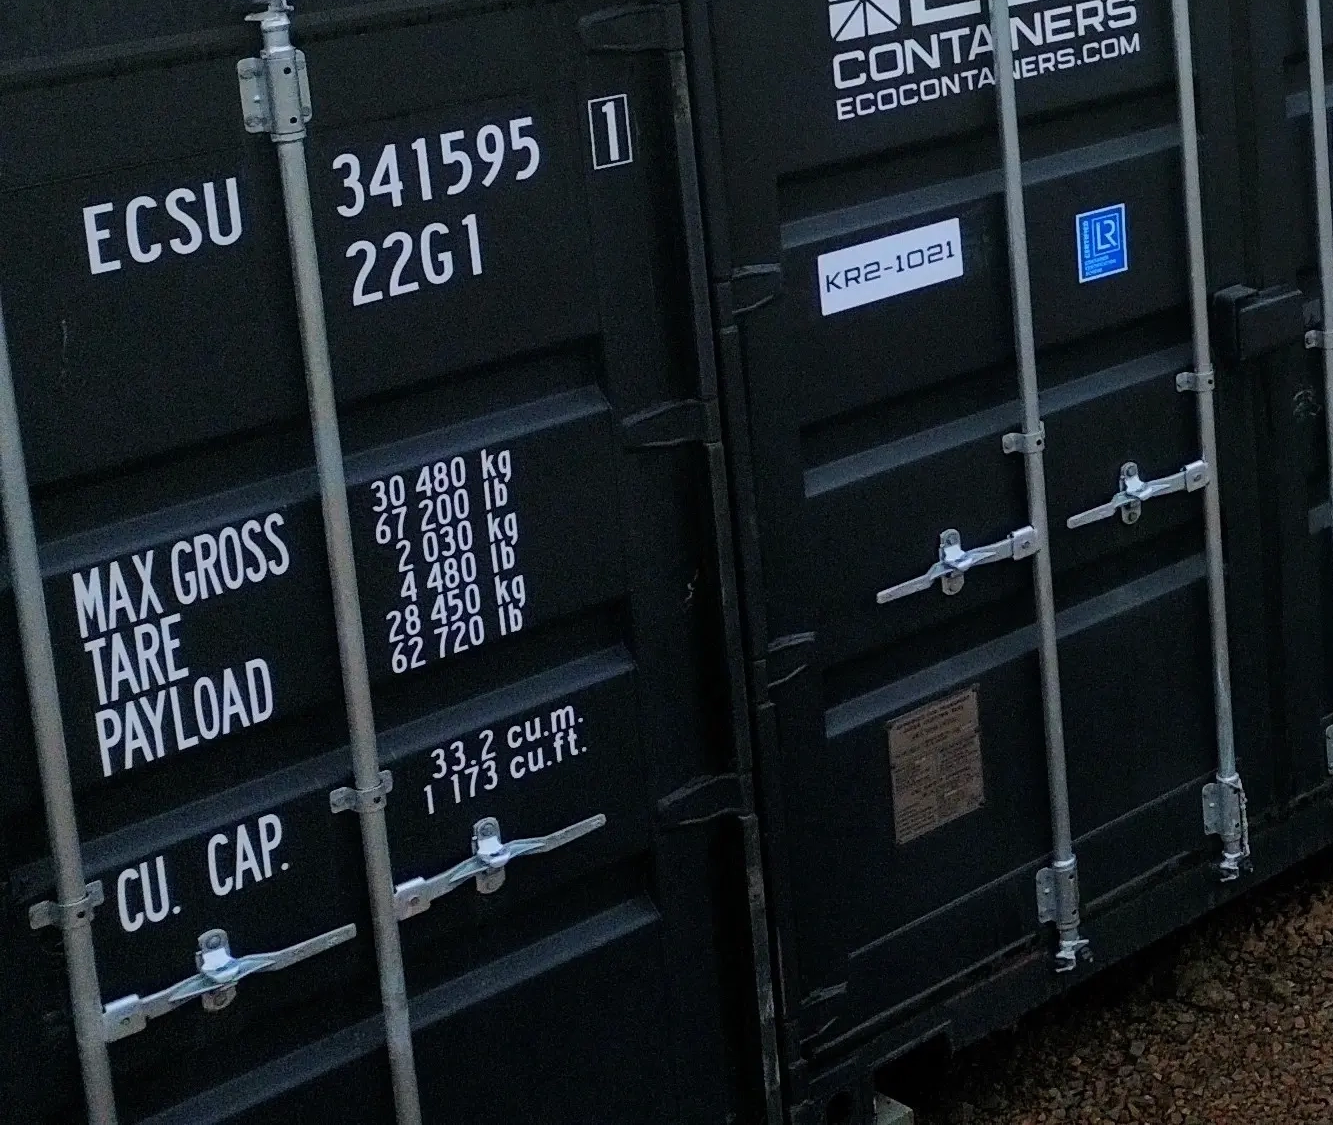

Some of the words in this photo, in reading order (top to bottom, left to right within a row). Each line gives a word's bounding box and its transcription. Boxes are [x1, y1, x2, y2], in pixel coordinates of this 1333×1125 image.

[836, 33, 1140, 120] ECOCONTAERS.COM
[83, 177, 244, 274] ECSU
[332, 116, 539, 218] 341595
[595, 97, 627, 165] 1
[346, 213, 485, 307] 22G1
[825, 241, 954, 292] KR2-1021
[371, 475, 405, 512] 30
[416, 457, 466, 496] 480
[481, 449, 512, 483] kg
[376, 506, 408, 544] 67
[418, 489, 469, 531] 200
[484, 478, 508, 510] lb
[72, 550, 163, 638] MAX
[171, 513, 289, 604] GROSS
[396, 540, 414, 572] 2
[422, 521, 473, 563] 030
[487, 512, 518, 545] kg
[400, 571, 417, 602] 4
[427, 552, 477, 593] 480
[491, 541, 515, 573] lb
[386, 604, 421, 643] 28
[431, 584, 481, 624] 450
[494, 575, 526, 608] kg
[391, 637, 426, 674] 62
[434, 615, 485, 658] 720
[498, 603, 523, 636] lb
[84, 613, 189, 705] TARE
[95, 658, 273, 777] PAYLOAD
[431, 730, 497, 779] 33.2
[507, 705, 584, 749] cu.m.
[424, 784, 435, 815] 1
[451, 760, 498, 804] 173
[510, 728, 587, 779] cu.ft.
[117, 854, 183, 932] CU.
[208, 815, 292, 898] CAP.
